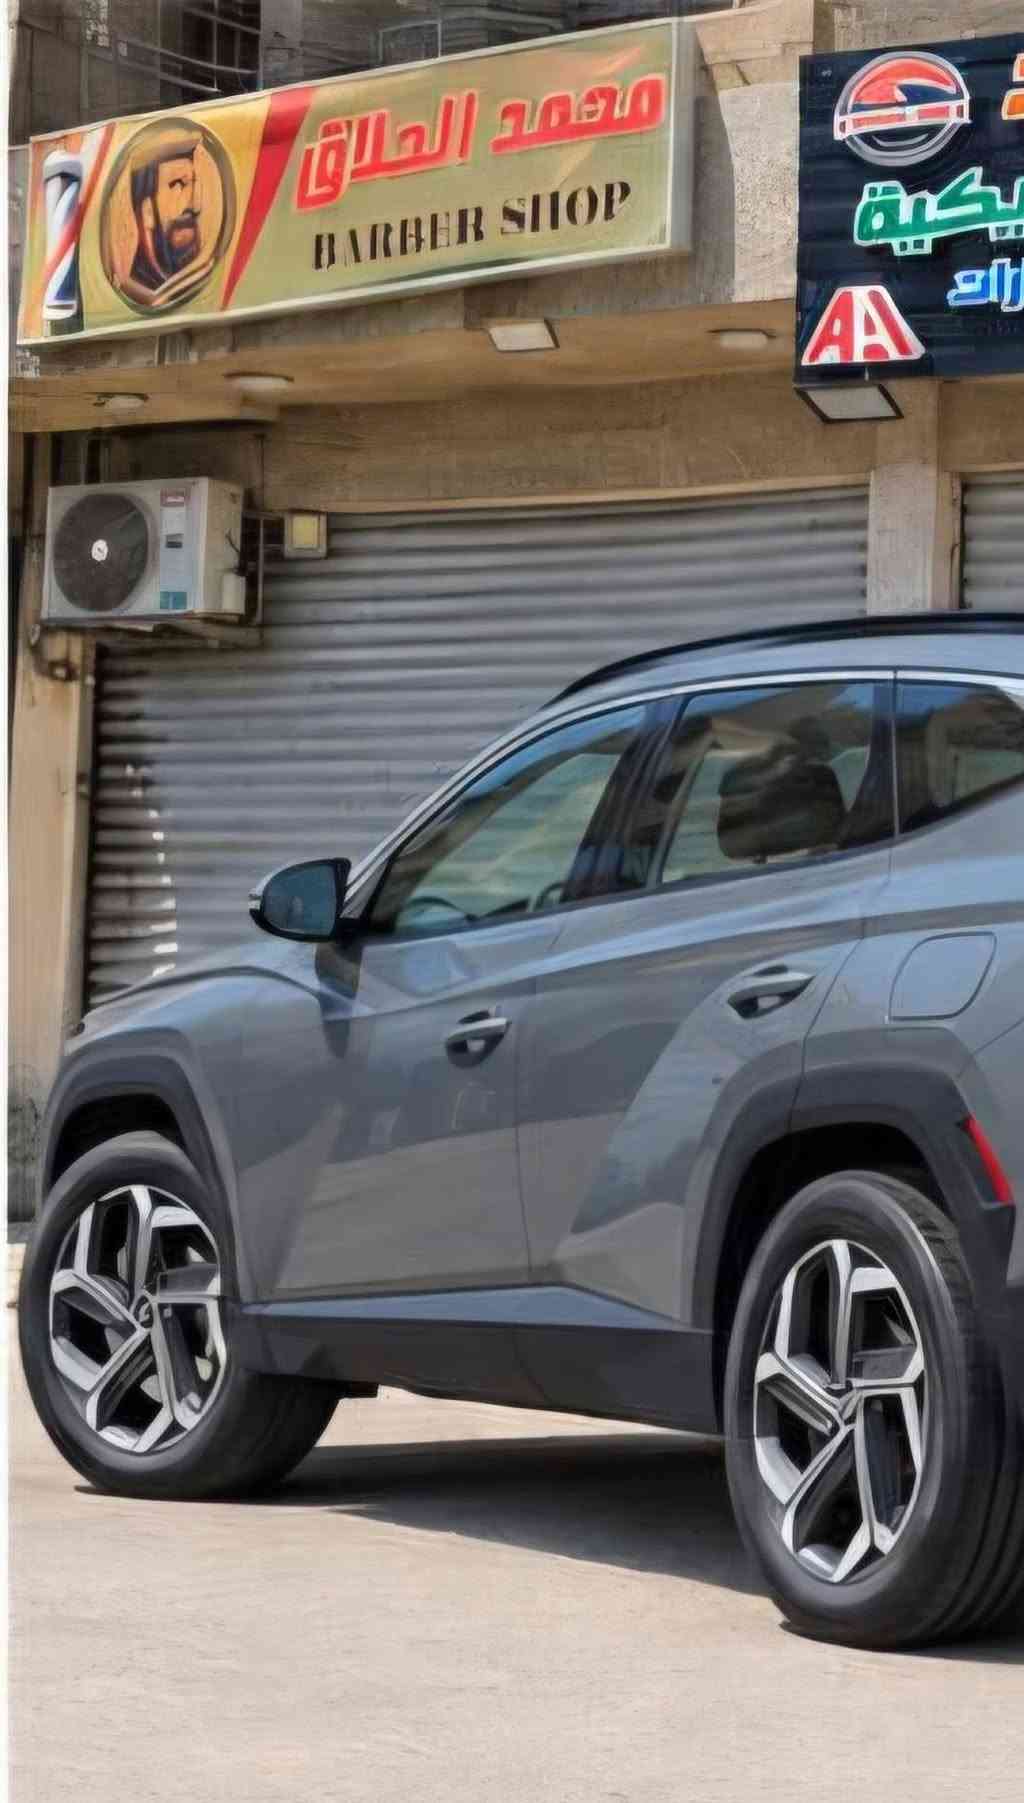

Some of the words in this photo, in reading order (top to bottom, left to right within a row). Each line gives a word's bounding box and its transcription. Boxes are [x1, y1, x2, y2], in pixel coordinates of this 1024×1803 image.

[296, 88, 480, 212] الحلاق
[489, 73, 667, 156] محمد
[313, 206, 486, 271] BARBER
[500, 180, 632, 236] SHOP
